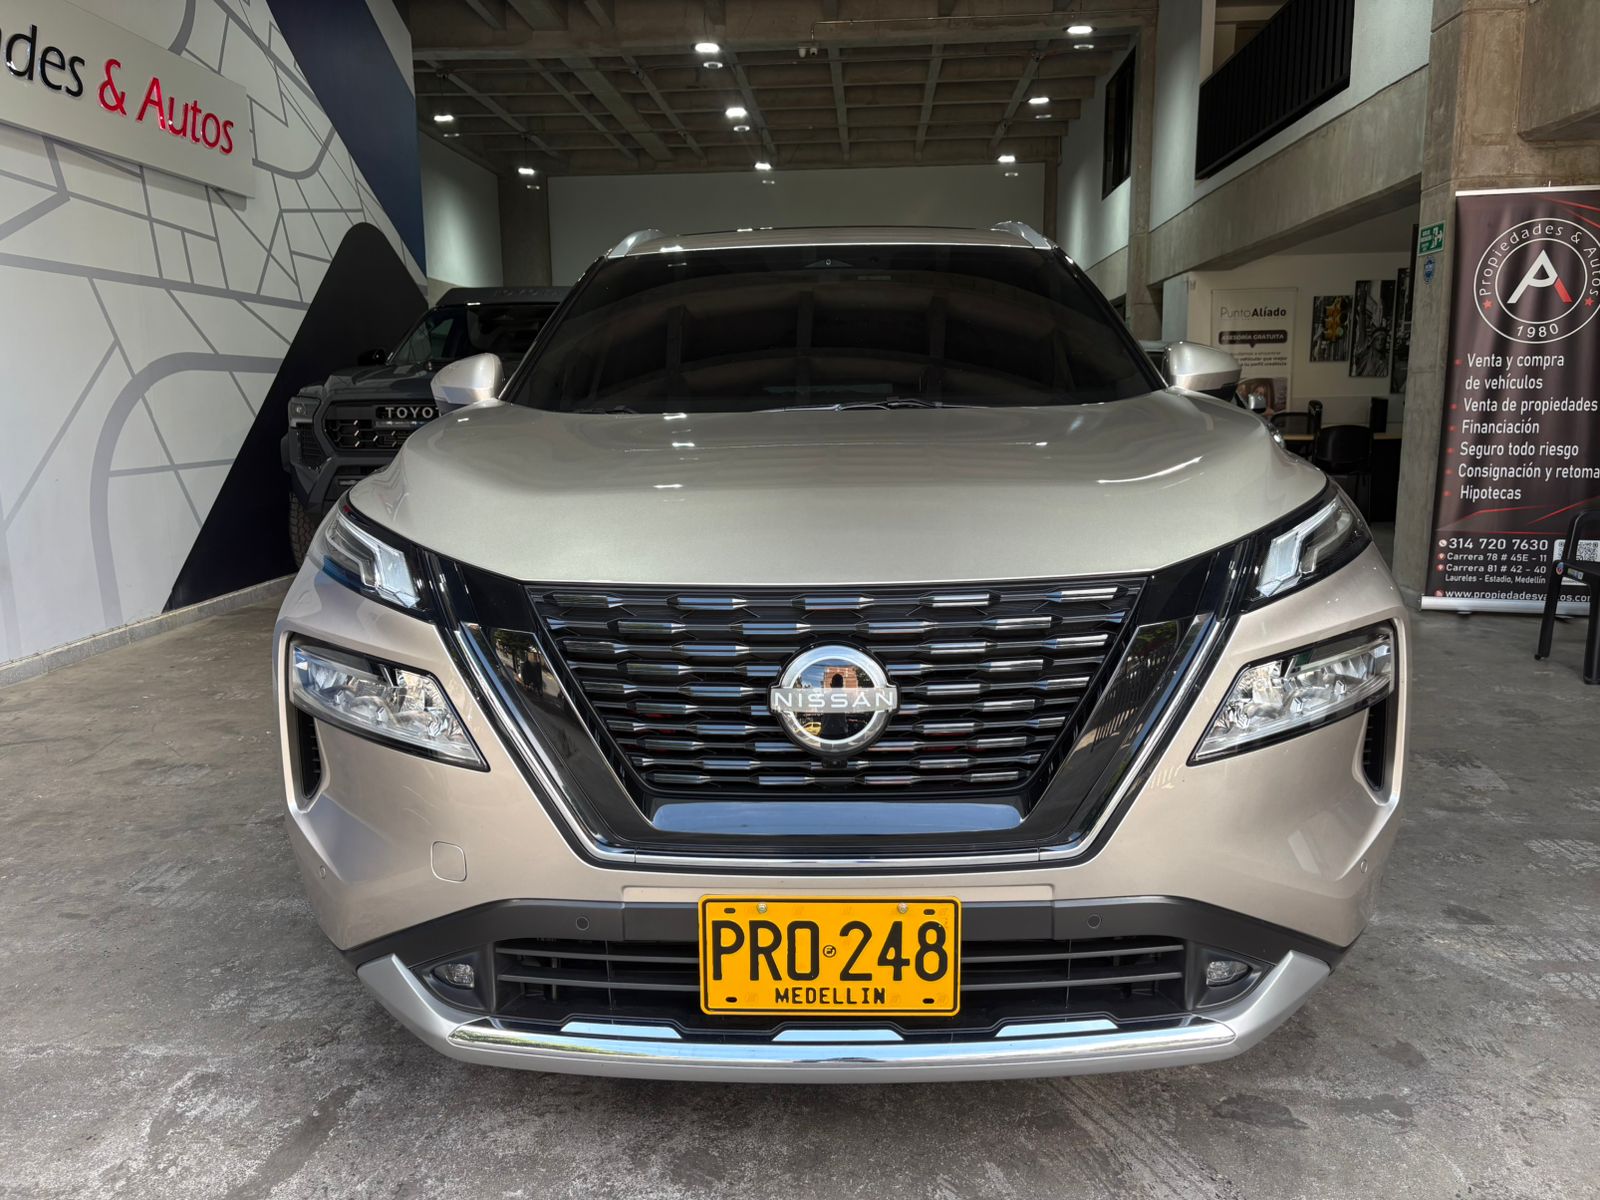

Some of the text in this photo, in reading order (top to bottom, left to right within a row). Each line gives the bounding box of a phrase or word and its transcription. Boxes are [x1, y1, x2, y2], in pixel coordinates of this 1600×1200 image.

[0, 24, 235, 155] des & Autos
[1479, 223, 1564, 296] Propiedades
[1570, 231, 1583, 244] &
[1583, 247, 1600, 296] Autos
[1516, 323, 1559, 338] 1980
[1467, 353, 1565, 371] Venta y compra
[1465, 373, 1543, 390] de vehículos
[385, 406, 441, 419] TOYO
[1463, 397, 1598, 415] Venta de propiedades
[1461, 418, 1540, 434] Financiación
[1459, 441, 1579, 459] Seguro todo riesgo
[1458, 462, 1600, 481] Consignación y retoma
[1460, 485, 1522, 503] Hipotecas
[1449, 538, 1548, 550] 314 720 7630
[1447, 552, 1484, 561] Carrera
[1486, 553, 1498, 561] 78
[1510, 554, 1529, 562] 45E
[1540, 554, 1547, 562] 11
[1445, 564, 1484, 572] Carrera
[1487, 564, 1497, 572] 81
[1500, 565, 1508, 573] #
[1510, 565, 1522, 573] 42
[1534, 566, 1547, 574] 40
[1445, 574, 1477, 582] Laureles
[1484, 575, 1513, 584] Estadio,
[774, 691, 893, 708] NISSAN
[711, 919, 948, 982] PRO 248
[775, 987, 886, 1005] MEDELLIN
